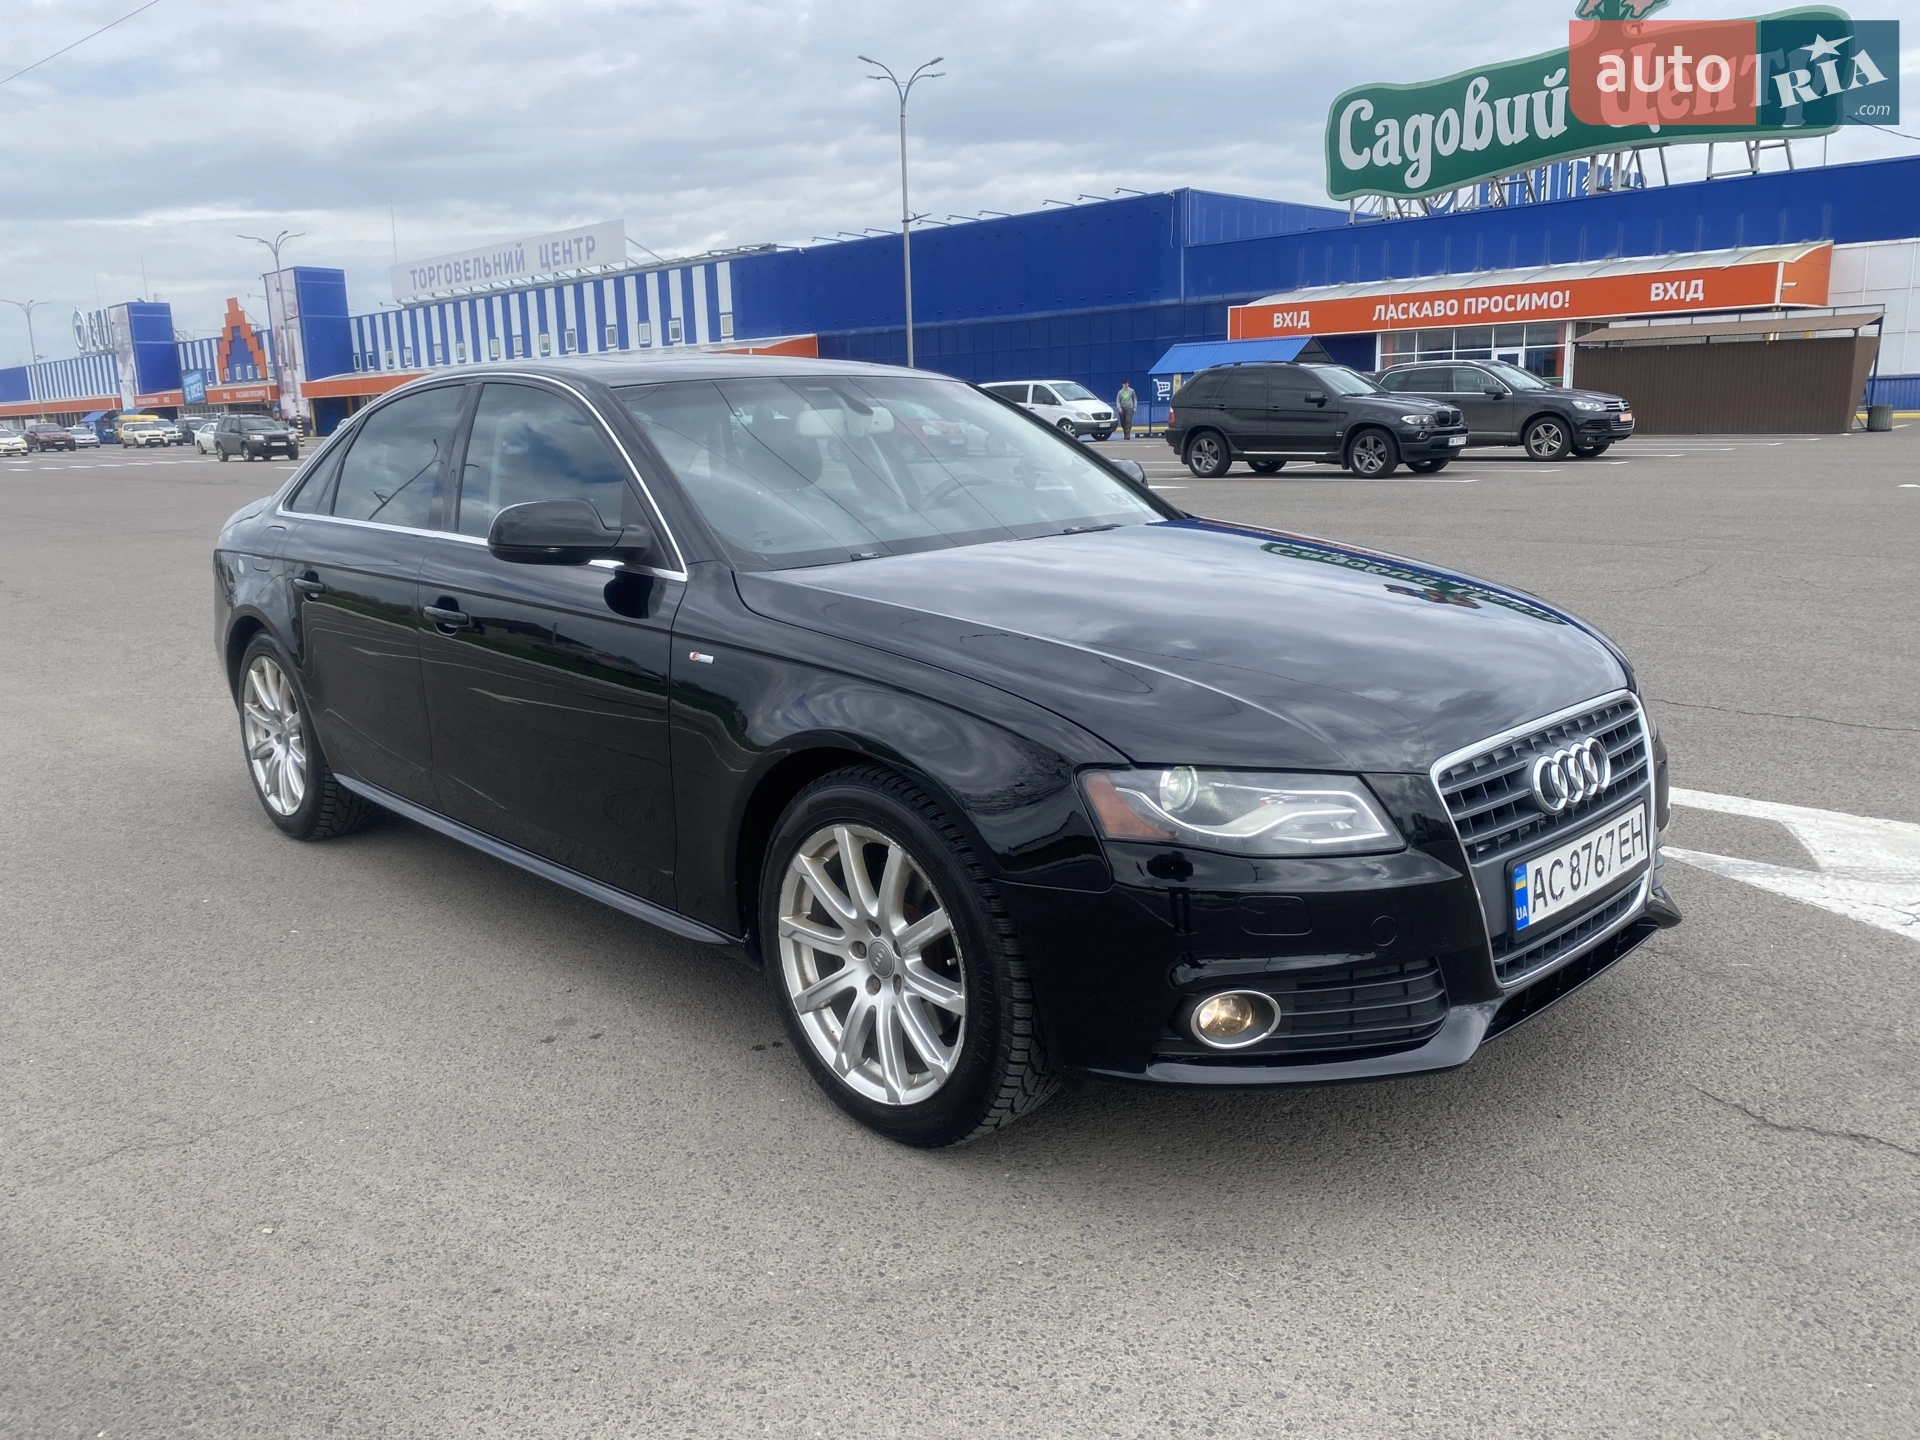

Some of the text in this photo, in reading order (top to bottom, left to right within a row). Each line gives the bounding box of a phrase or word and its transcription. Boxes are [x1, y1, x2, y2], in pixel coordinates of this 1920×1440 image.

[1338, 67, 1569, 188] Садовий
[410, 235, 596, 290] ТОРГОВЕЛЬНИЙ ЦЕНТР
[1373, 290, 1571, 322] ЛАСКАВО ПРОСИМО!
[1651, 279, 1705, 302] ВХІД
[1273, 310, 1311, 329] ВХІД
[1569, 829, 1615, 892] 8767
[1516, 905, 1528, 920] UA
